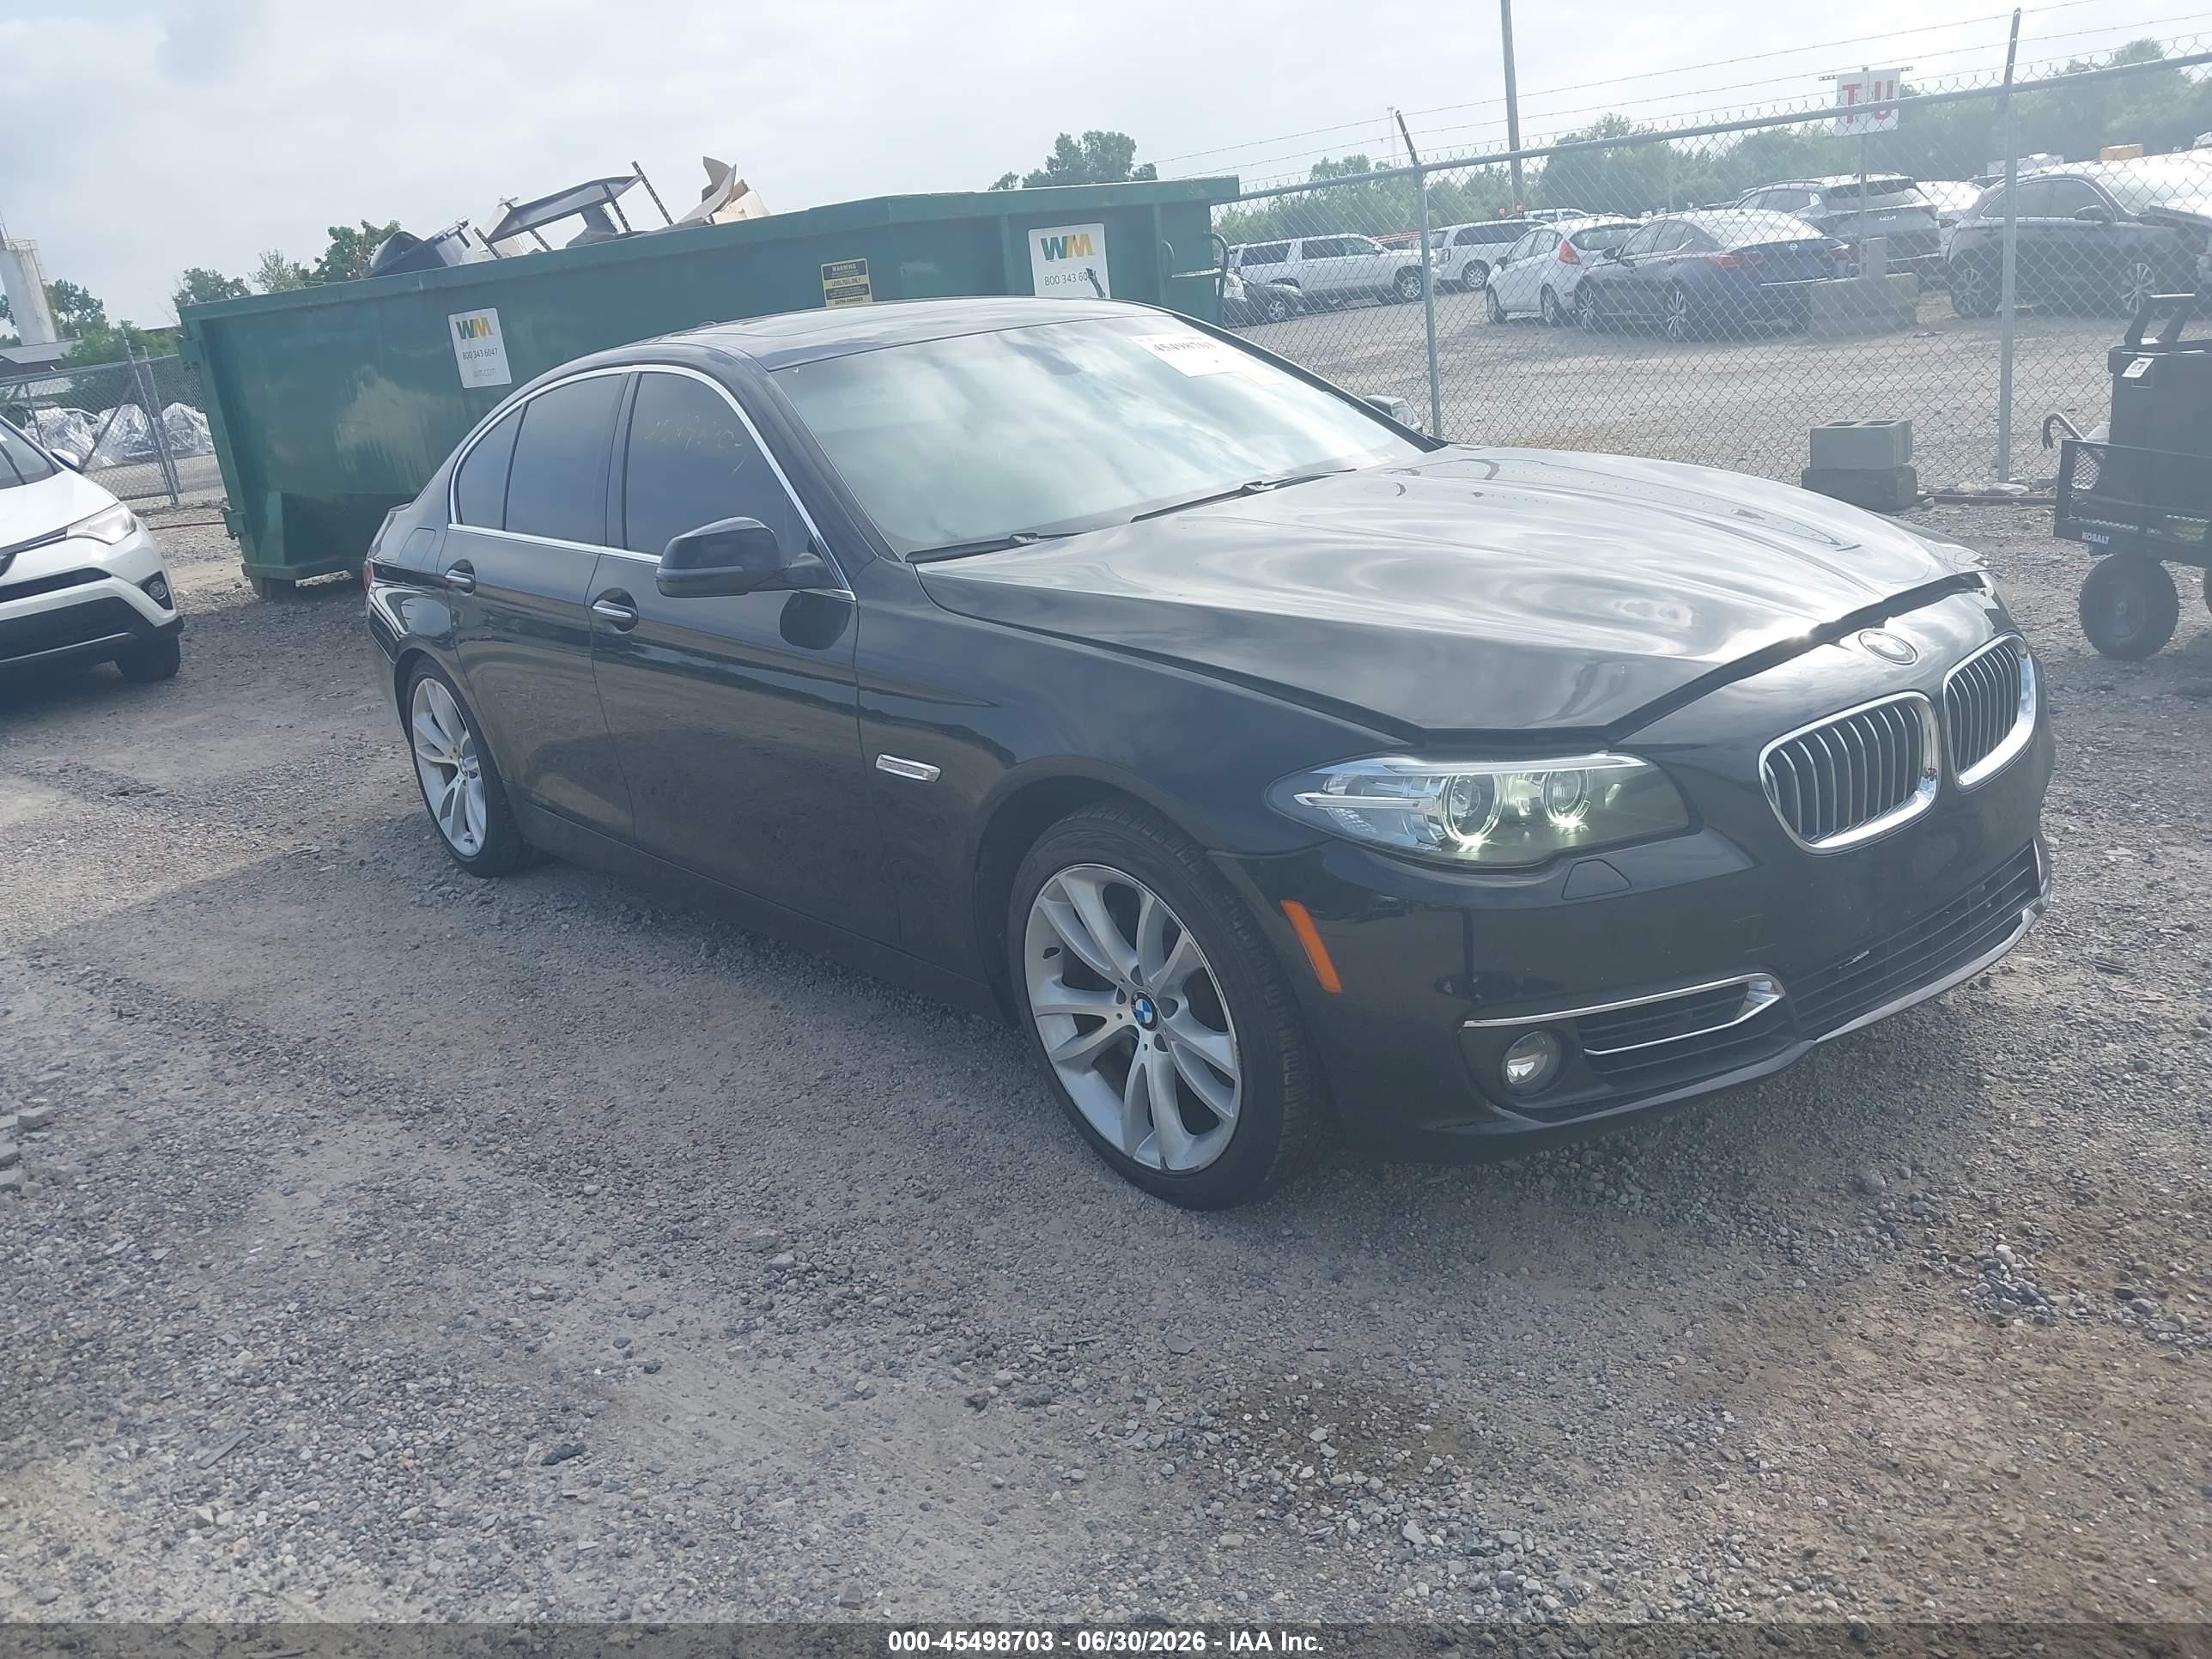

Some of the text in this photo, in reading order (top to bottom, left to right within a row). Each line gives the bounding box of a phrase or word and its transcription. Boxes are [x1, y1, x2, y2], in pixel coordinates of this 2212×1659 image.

[1040, 234, 1093, 261] WM
[1044, 275, 1060, 286] 800
[1062, 273, 1077, 283] 343
[455, 317, 494, 339] WM
[473, 349, 483, 358] 343
